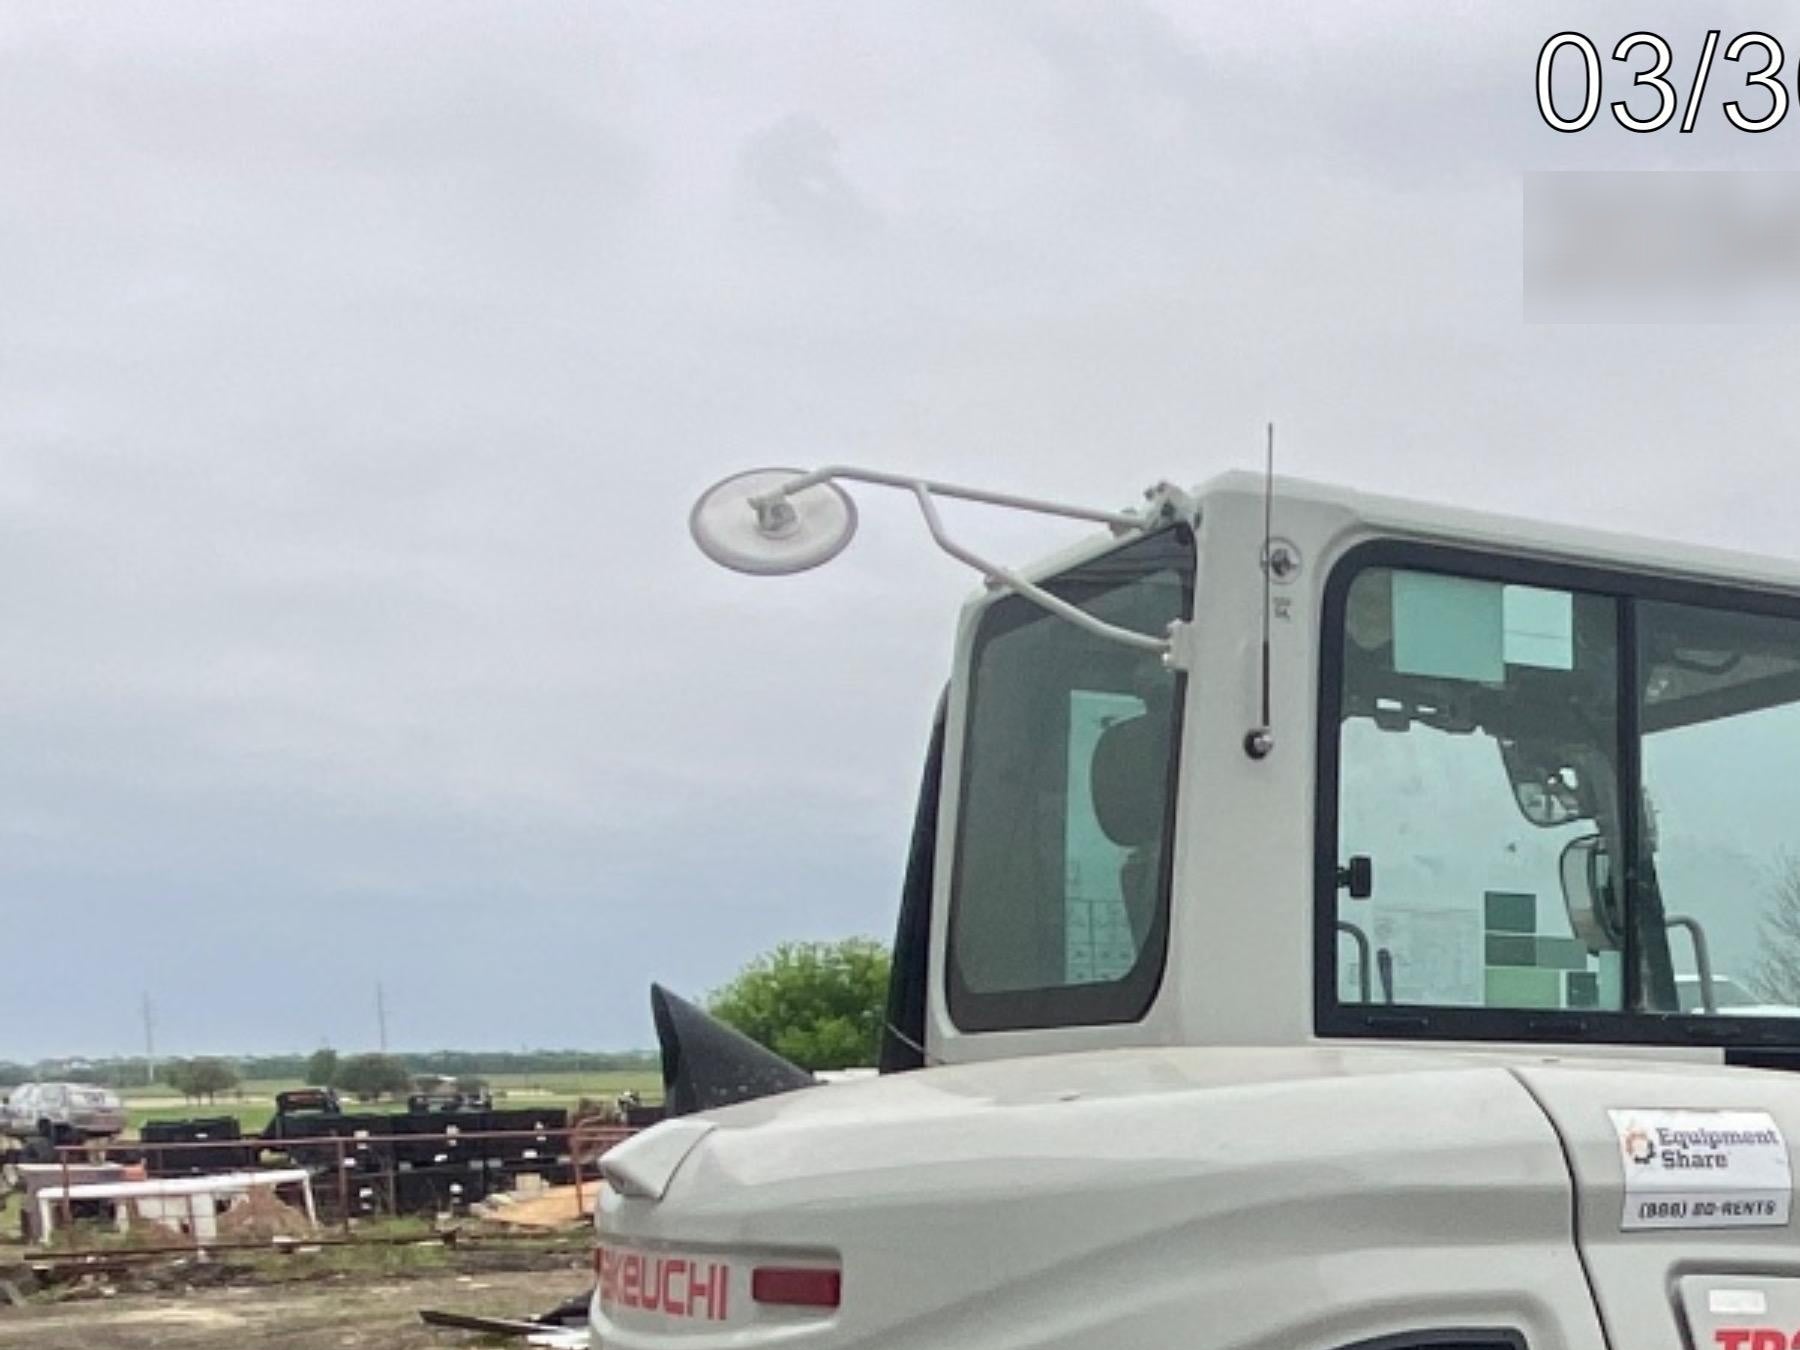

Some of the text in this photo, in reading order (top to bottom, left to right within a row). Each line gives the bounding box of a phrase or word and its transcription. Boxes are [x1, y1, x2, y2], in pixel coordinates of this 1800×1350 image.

[1656, 1128, 1779, 1149] Equipment
[1661, 1150, 1729, 1168] Share
[594, 1248, 729, 1321] KEUCHI
